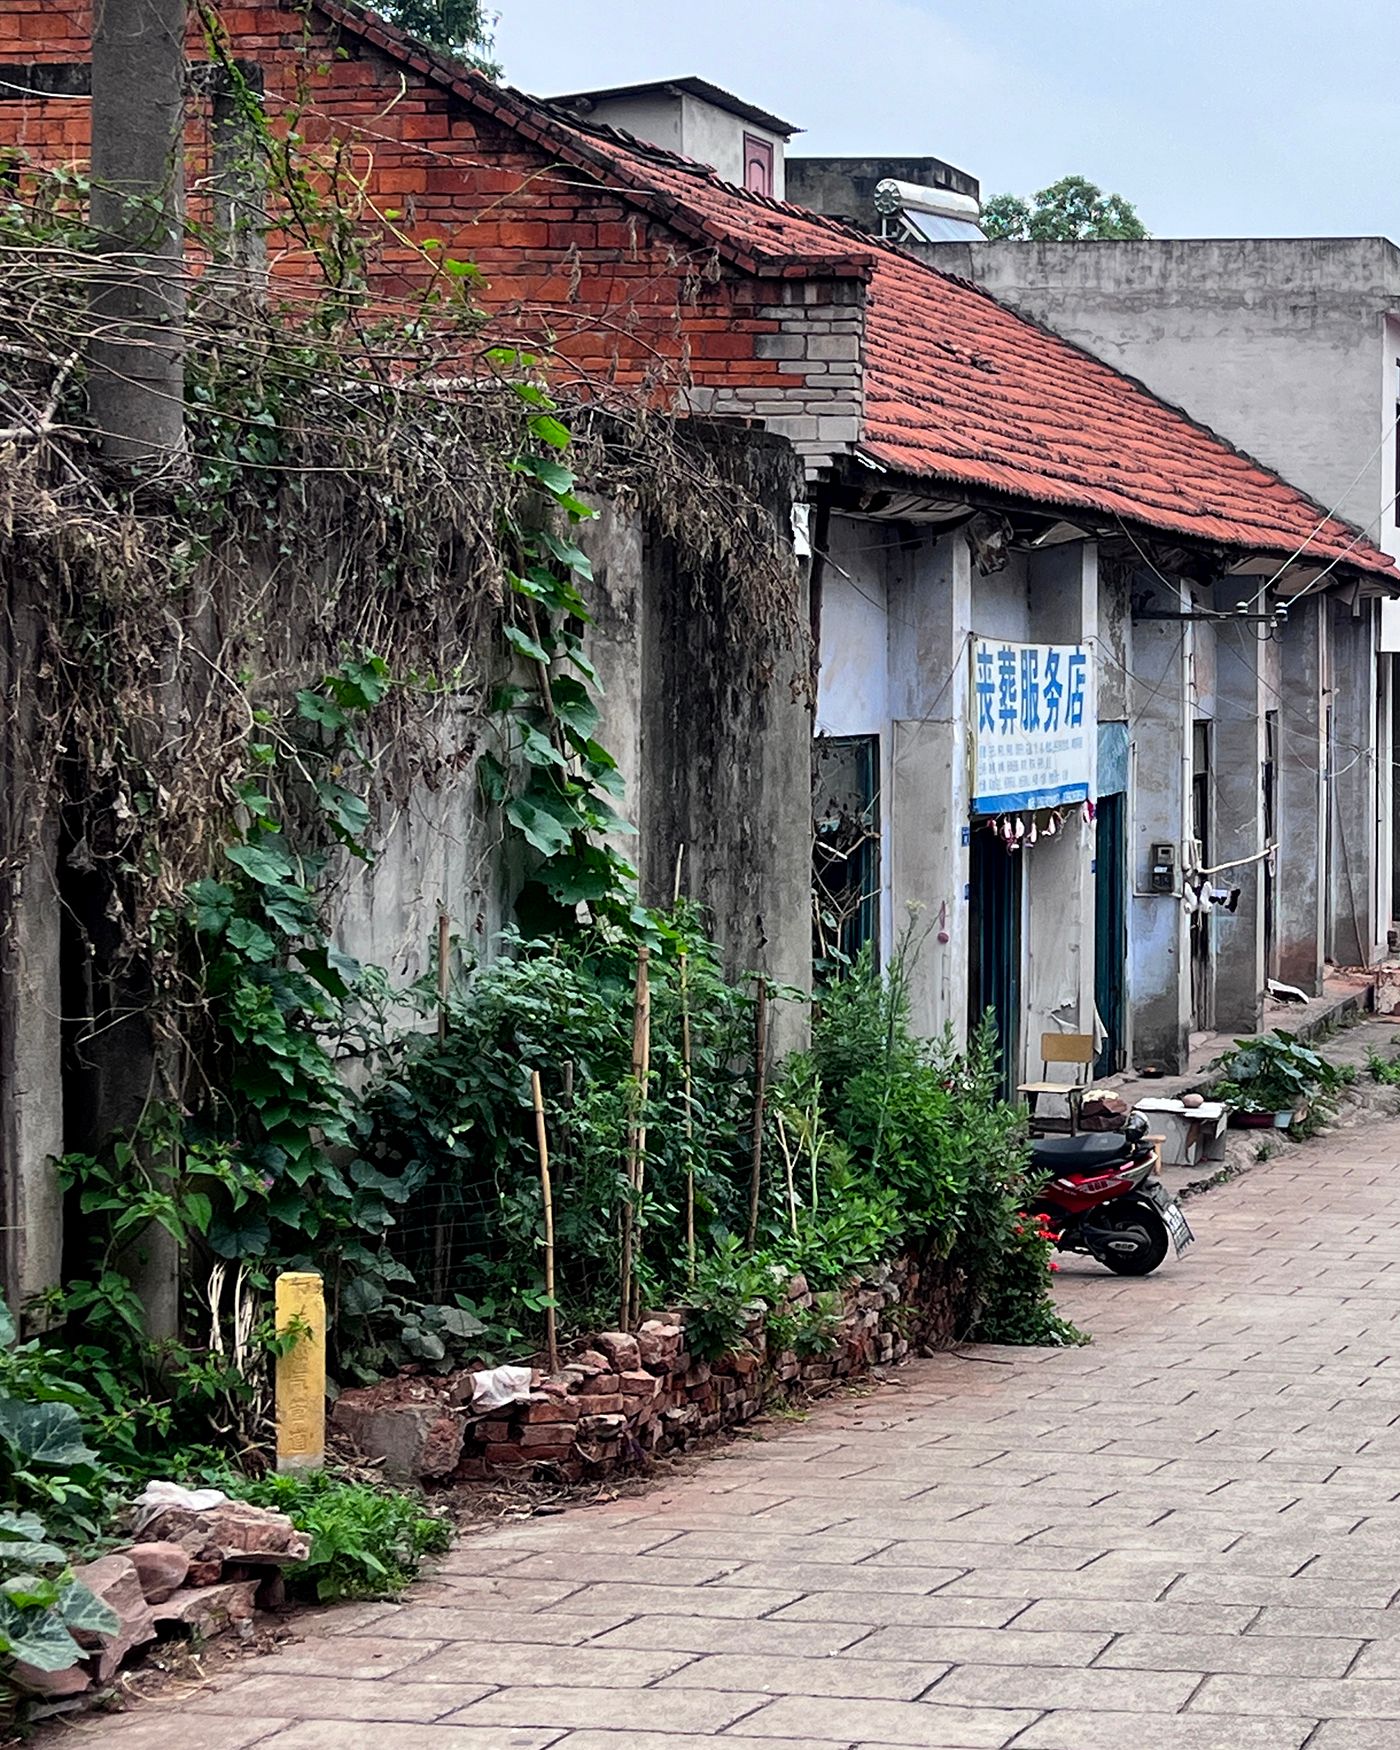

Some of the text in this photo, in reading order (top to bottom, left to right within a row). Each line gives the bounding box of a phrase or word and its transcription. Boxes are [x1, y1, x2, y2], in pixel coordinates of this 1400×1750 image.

[976, 643, 1086, 734] 丧葬服务店
